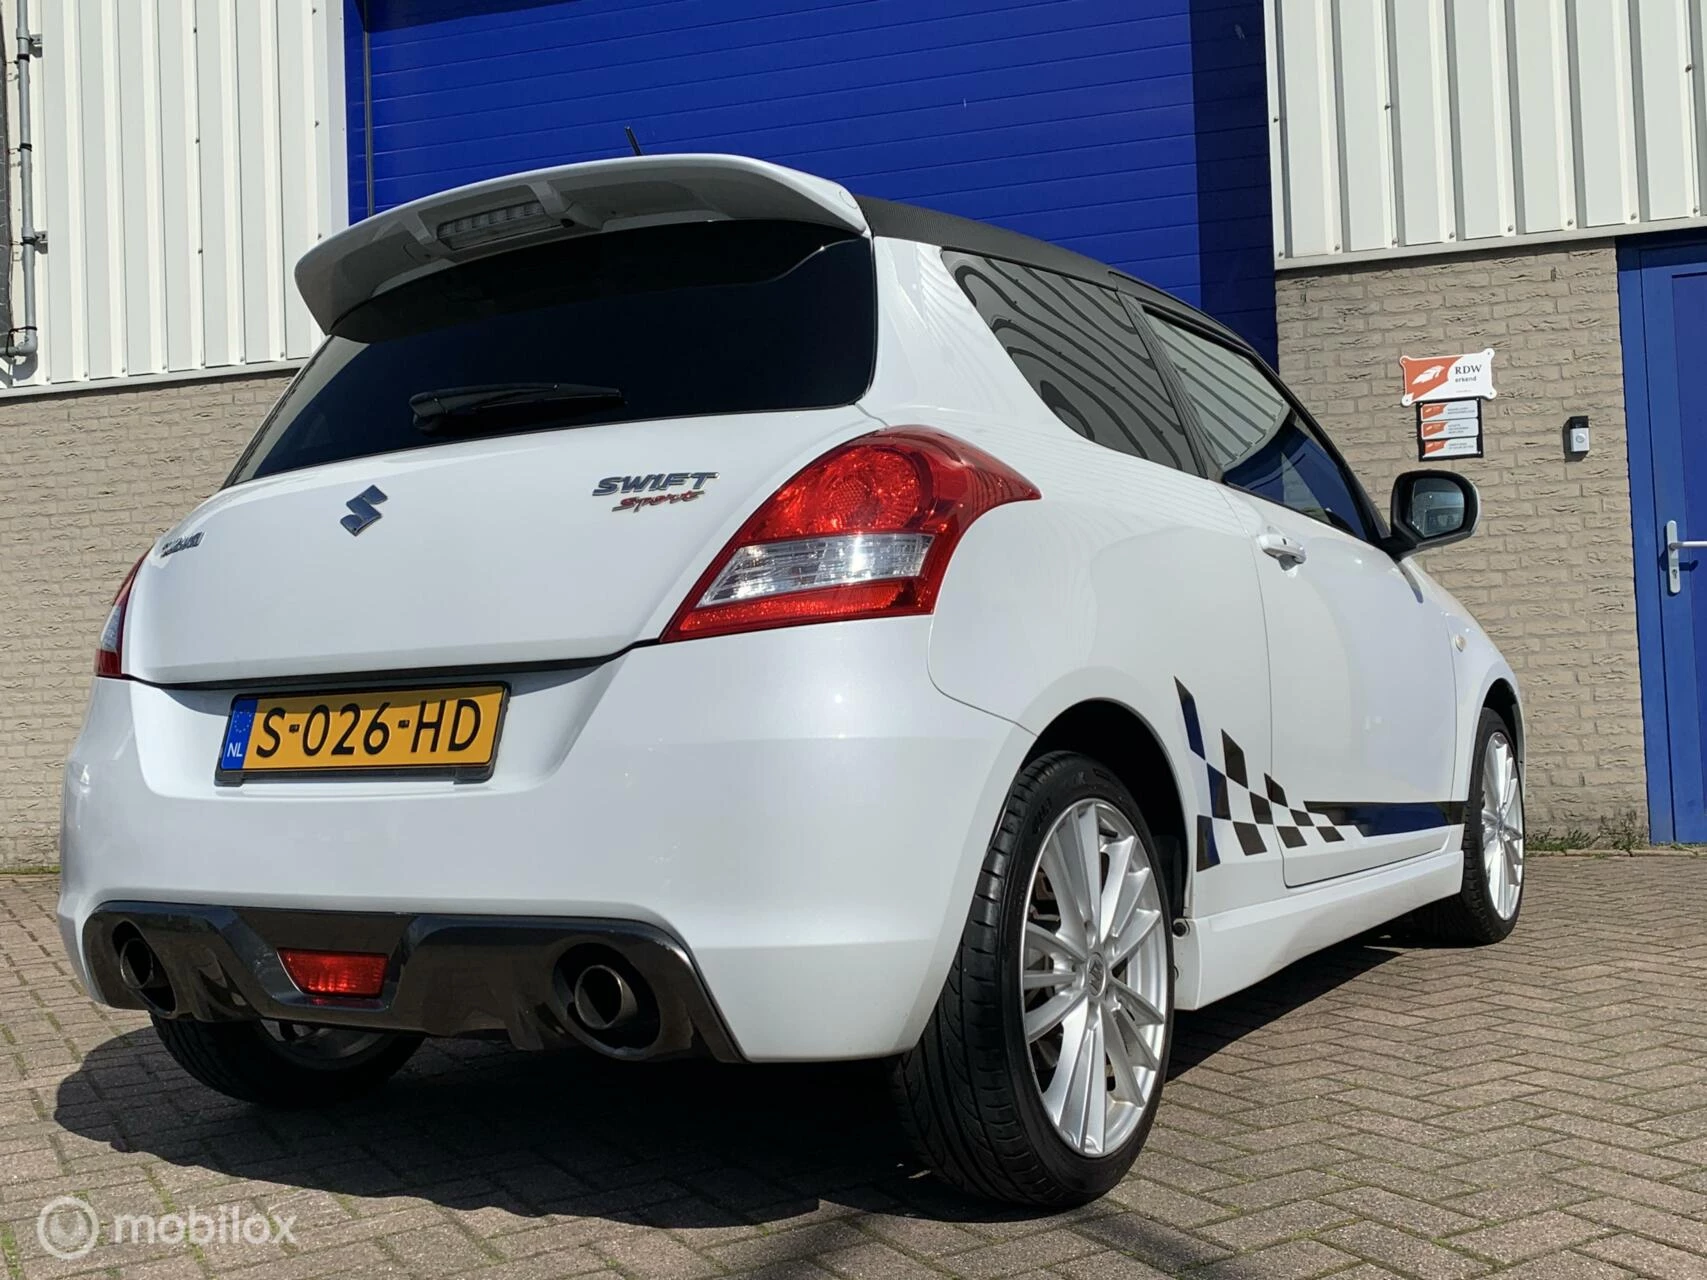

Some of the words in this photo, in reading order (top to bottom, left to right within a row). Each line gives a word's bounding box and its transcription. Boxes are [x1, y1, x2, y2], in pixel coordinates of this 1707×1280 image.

[1454, 364, 1482, 375] RDW
[592, 472, 720, 496] SWIFT
[611, 490, 705, 513] Sport
[256, 698, 482, 759] S-026-HD
[227, 742, 243, 758] NL
